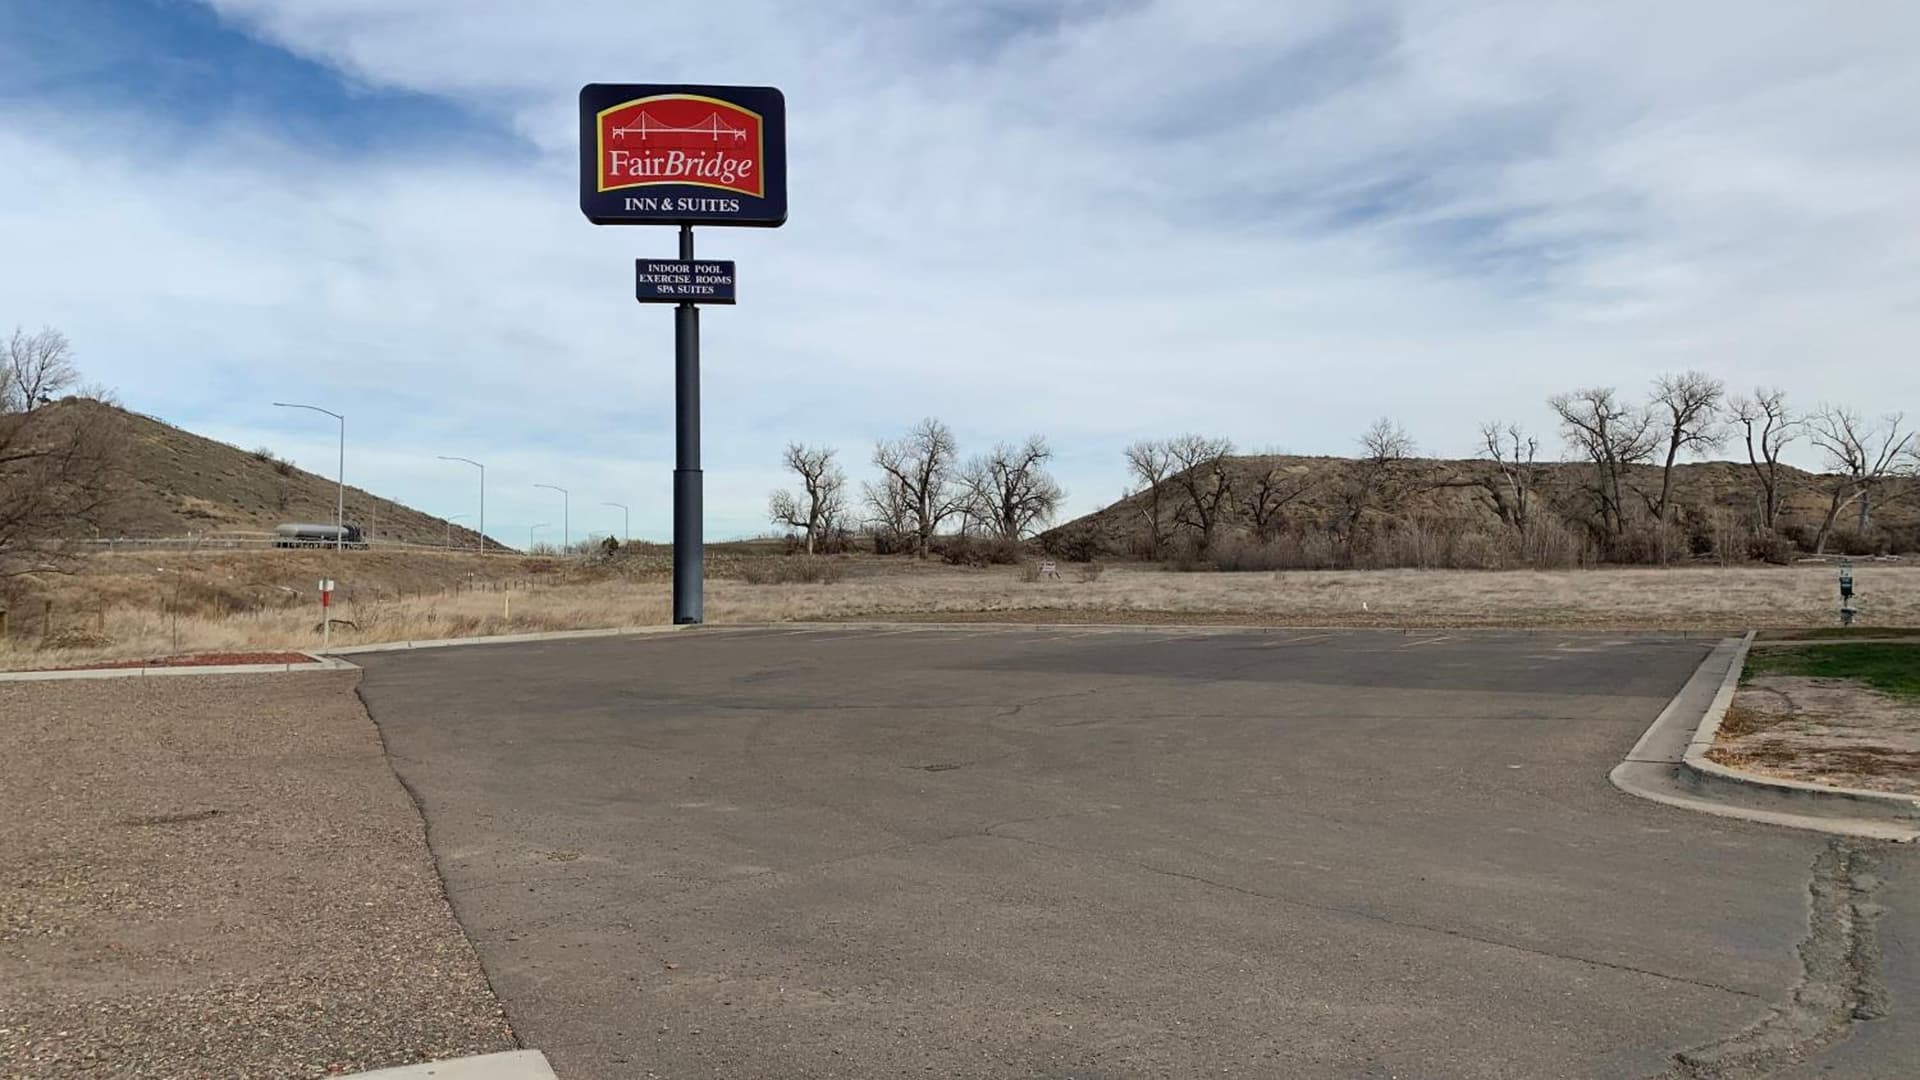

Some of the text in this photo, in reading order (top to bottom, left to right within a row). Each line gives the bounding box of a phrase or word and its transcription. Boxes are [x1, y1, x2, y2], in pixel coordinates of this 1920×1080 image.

[609, 150, 753, 184] FairBridge
[624, 197, 740, 212] INN & SUITES
[648, 264, 723, 273] INDOOR POOL
[639, 274, 732, 284] EXERCISE ROOMS
[656, 285, 714, 294] SPA SUITES
